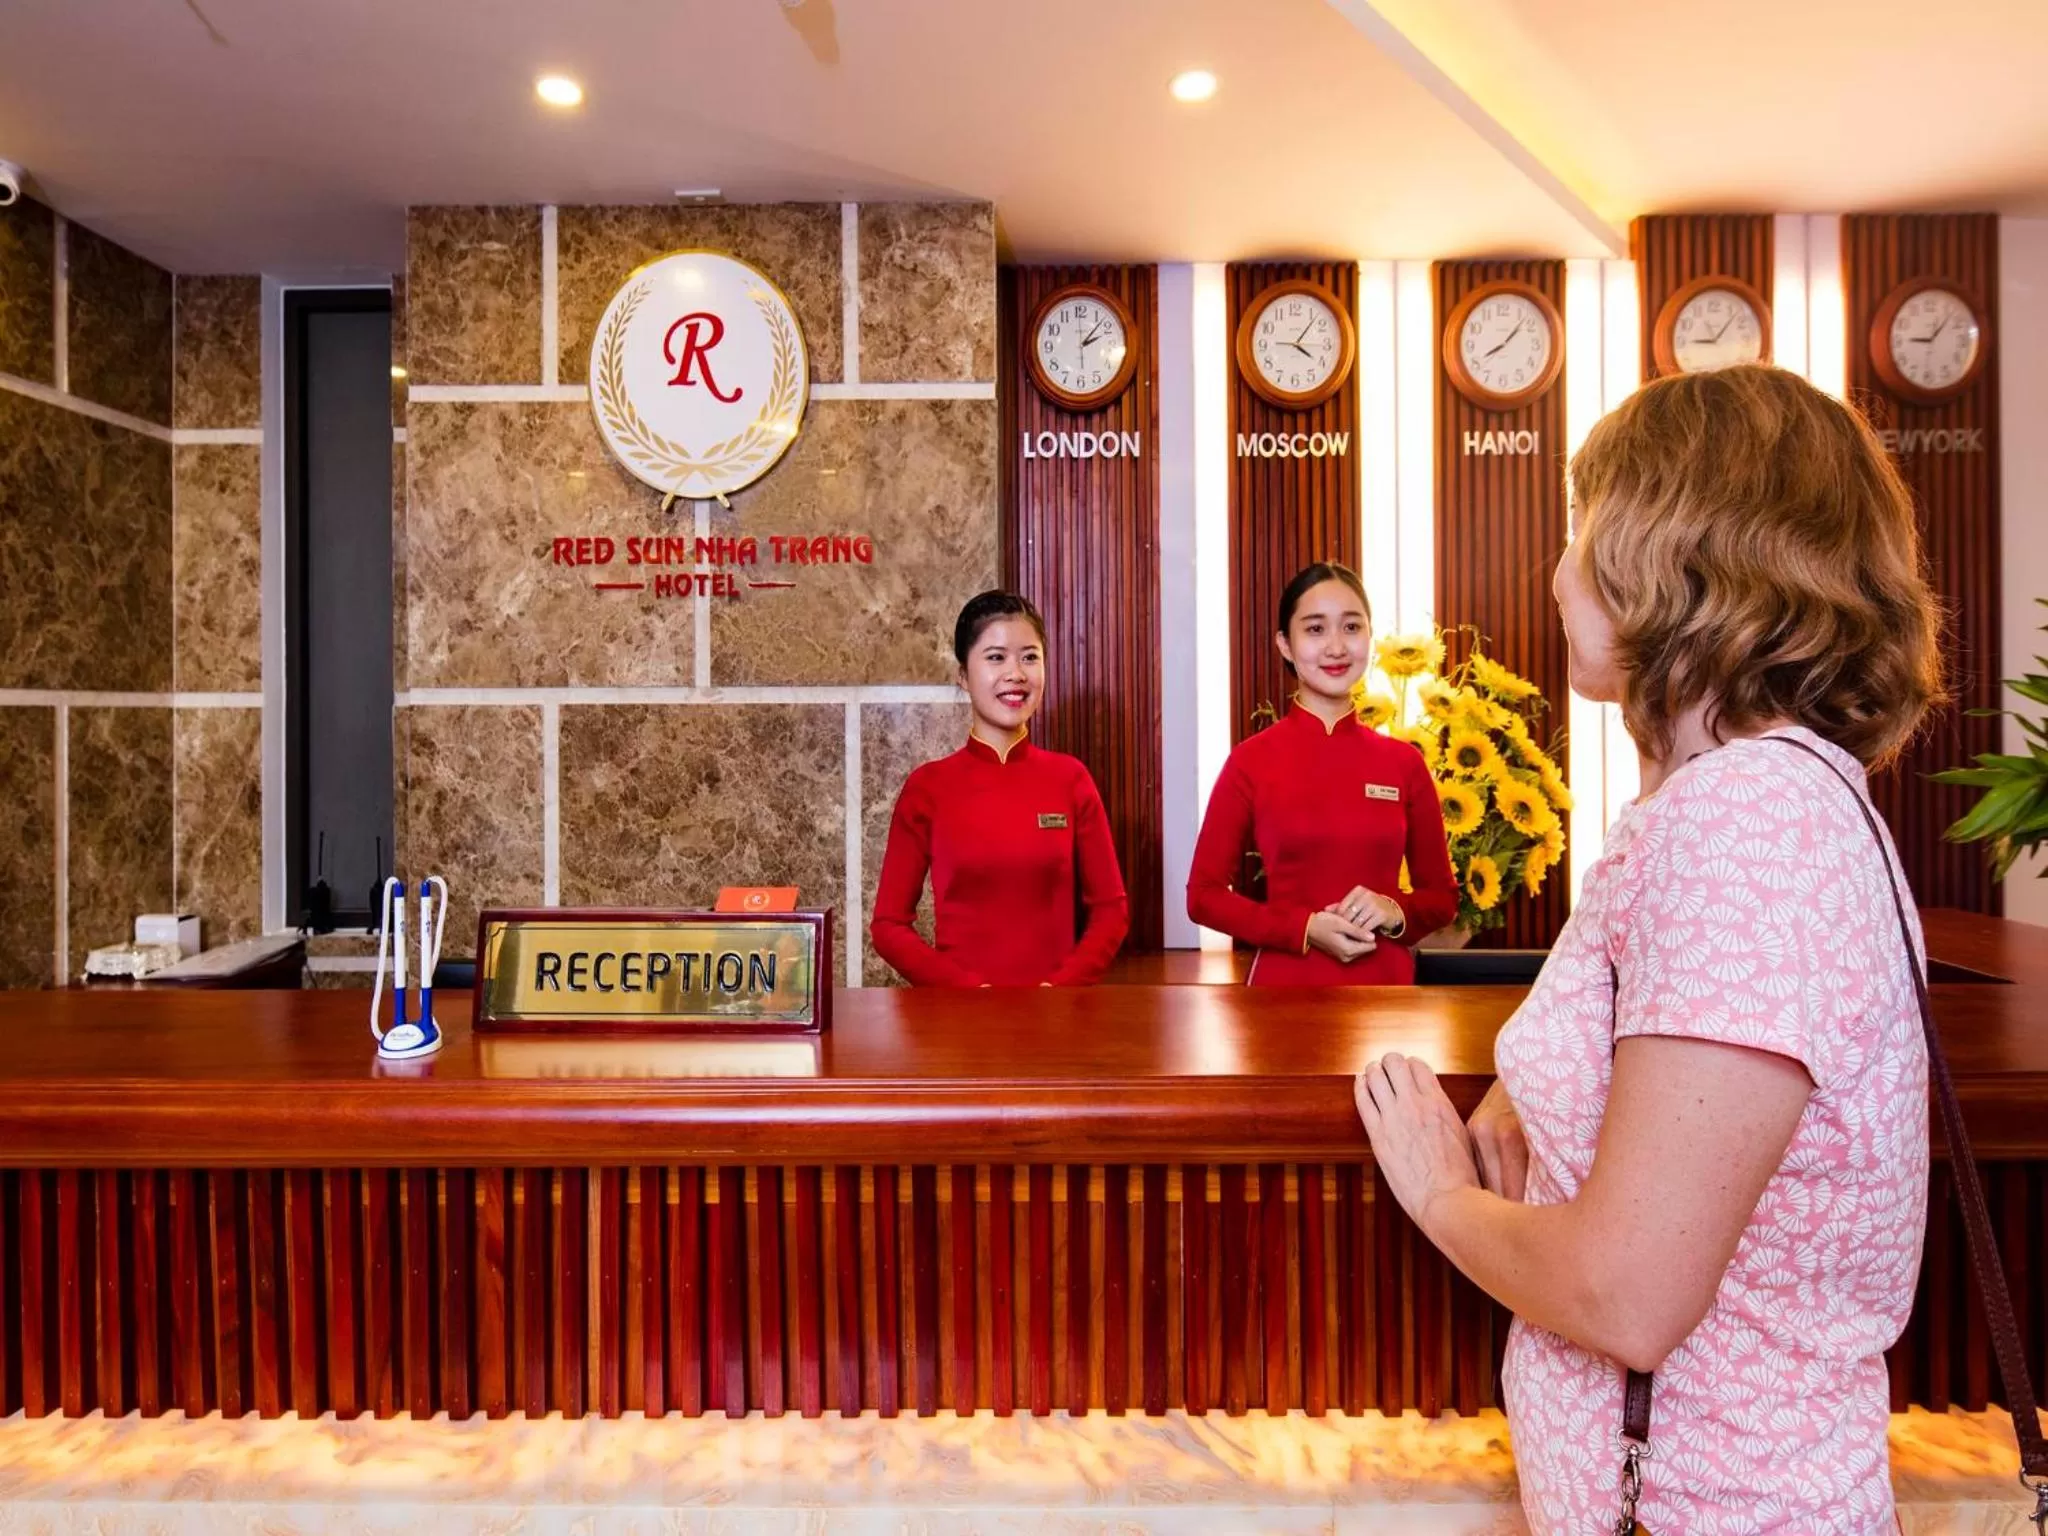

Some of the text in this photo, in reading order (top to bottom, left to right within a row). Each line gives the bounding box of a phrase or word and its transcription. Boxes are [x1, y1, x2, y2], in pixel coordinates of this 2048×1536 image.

[1060, 309, 1069, 323] 11
[1074, 305, 1088, 319] 12
[1275, 308, 1284, 321] 11
[1289, 302, 1302, 317] 12
[1048, 322, 1060, 337] 10
[1262, 321, 1275, 335] 10
[1318, 319, 1328, 333] 2
[1044, 340, 1054, 354] 9
[1322, 337, 1333, 351] 3
[663, 312, 743, 403] R
[1049, 358, 1059, 371] 8
[1263, 357, 1274, 370] 8
[1061, 370, 1070, 384] 7
[1076, 374, 1086, 389] 6
[1091, 370, 1102, 384] 5
[1275, 370, 1284, 383] 7
[1290, 372, 1300, 388] 6
[1307, 368, 1316, 382] 5
[1023, 431, 1140, 458] LONDON
[1237, 432, 1350, 458] MOSCOW
[1463, 430, 1539, 456] HANOI
[553, 535, 873, 567] RED SUN NHA TRANG
[654, 573, 740, 598] HOTEL
[534, 952, 776, 993] RECEPTION
